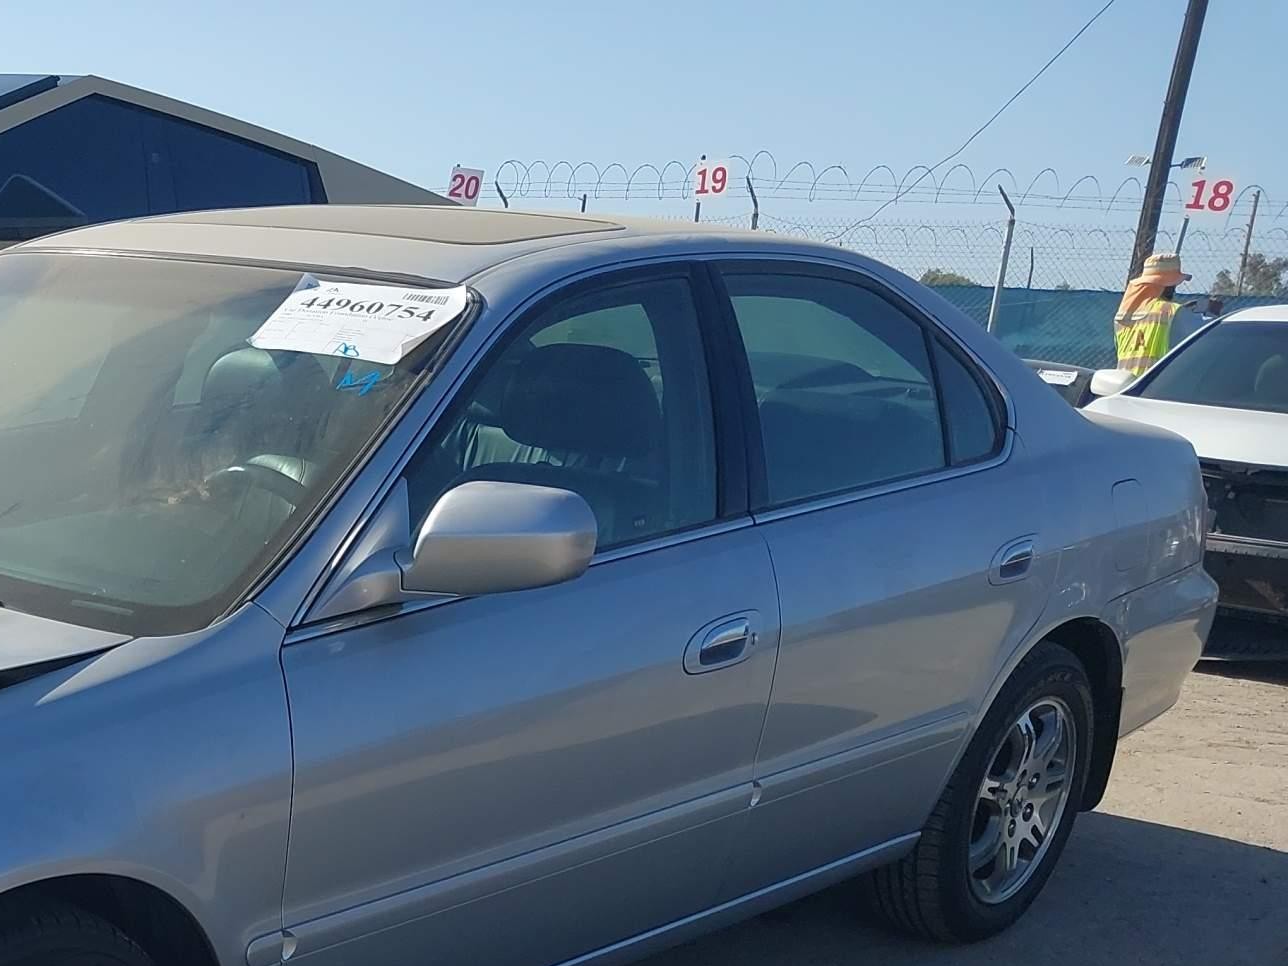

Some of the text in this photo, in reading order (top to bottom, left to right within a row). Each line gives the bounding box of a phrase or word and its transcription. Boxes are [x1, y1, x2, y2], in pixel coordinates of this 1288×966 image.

[448, 173, 480, 200] 20
[696, 167, 727, 195] 19
[1185, 180, 1233, 212] 18
[301, 296, 436, 322] 44960754
